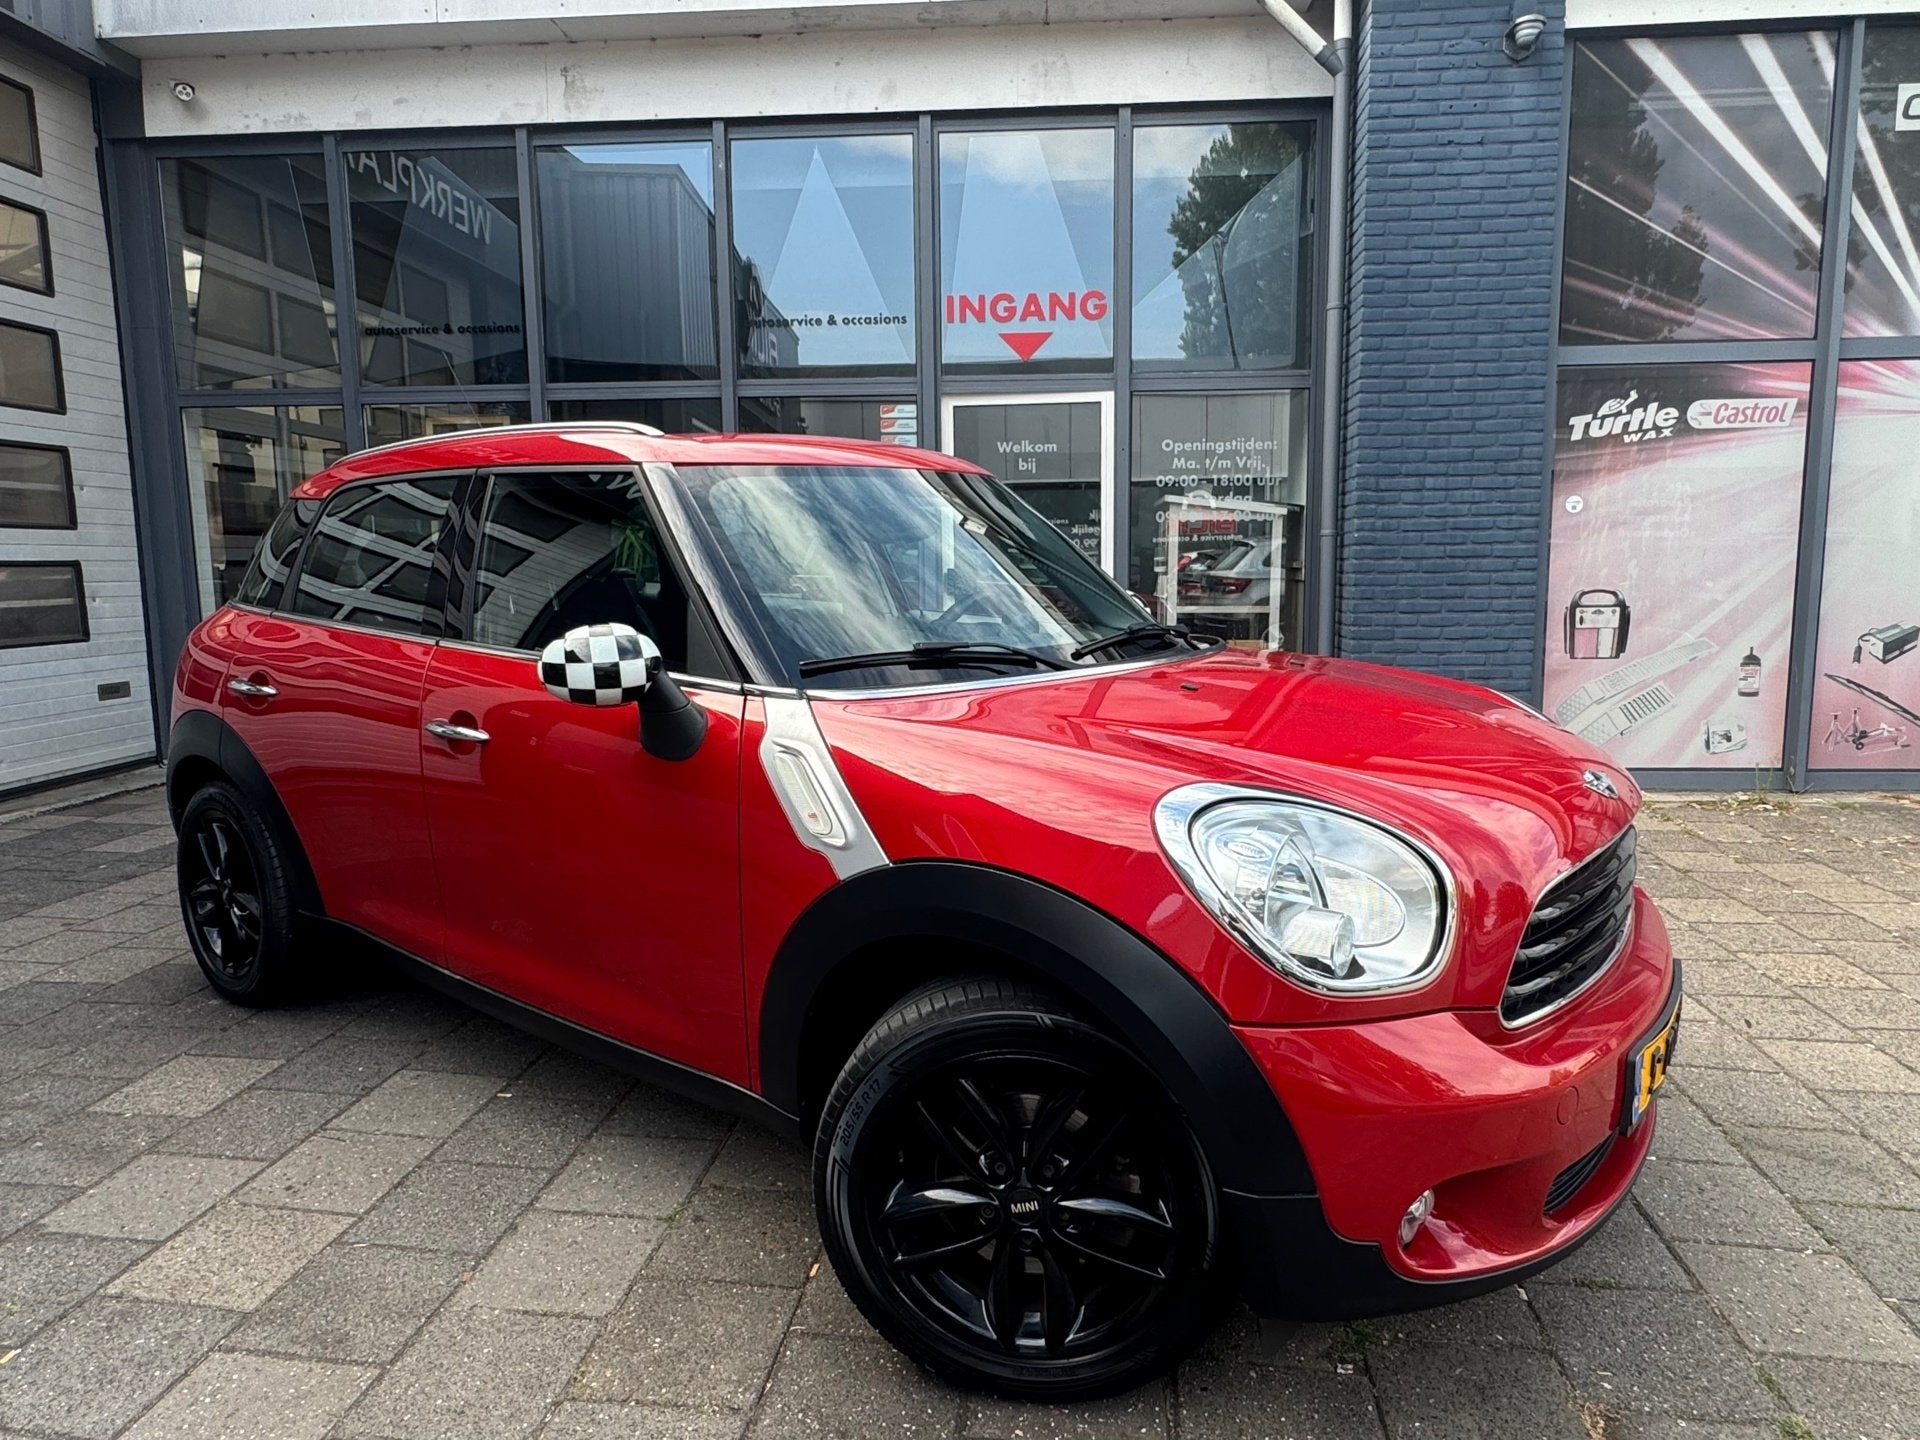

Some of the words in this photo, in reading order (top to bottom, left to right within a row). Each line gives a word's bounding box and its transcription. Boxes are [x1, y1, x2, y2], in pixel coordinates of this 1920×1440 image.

[946, 290, 1108, 324] INGANG
[827, 315, 838, 326] &
[842, 312, 907, 326] occasions
[365, 321, 438, 336] autoservice
[442, 323, 453, 335] &
[457, 321, 520, 336] occasions
[1569, 401, 1680, 441] Turtle
[1713, 402, 1788, 425] Castrol
[997, 440, 1057, 453] Welkom
[1161, 437, 1278, 454] Openingstijden:
[1018, 457, 1036, 473] bij
[1172, 457, 1200, 469] Ma.
[1205, 456, 1231, 471] t/m
[1236, 455, 1266, 471] Vrij.
[1156, 475, 1198, 487] 09:00
[1212, 474, 1252, 487] 18:00
[1257, 477, 1281, 486] uur
[840, 1101, 864, 1146] 205/55
[861, 1091, 871, 1104] R
[870, 1078, 881, 1095] 17
[1010, 1200, 1039, 1215] MINI
